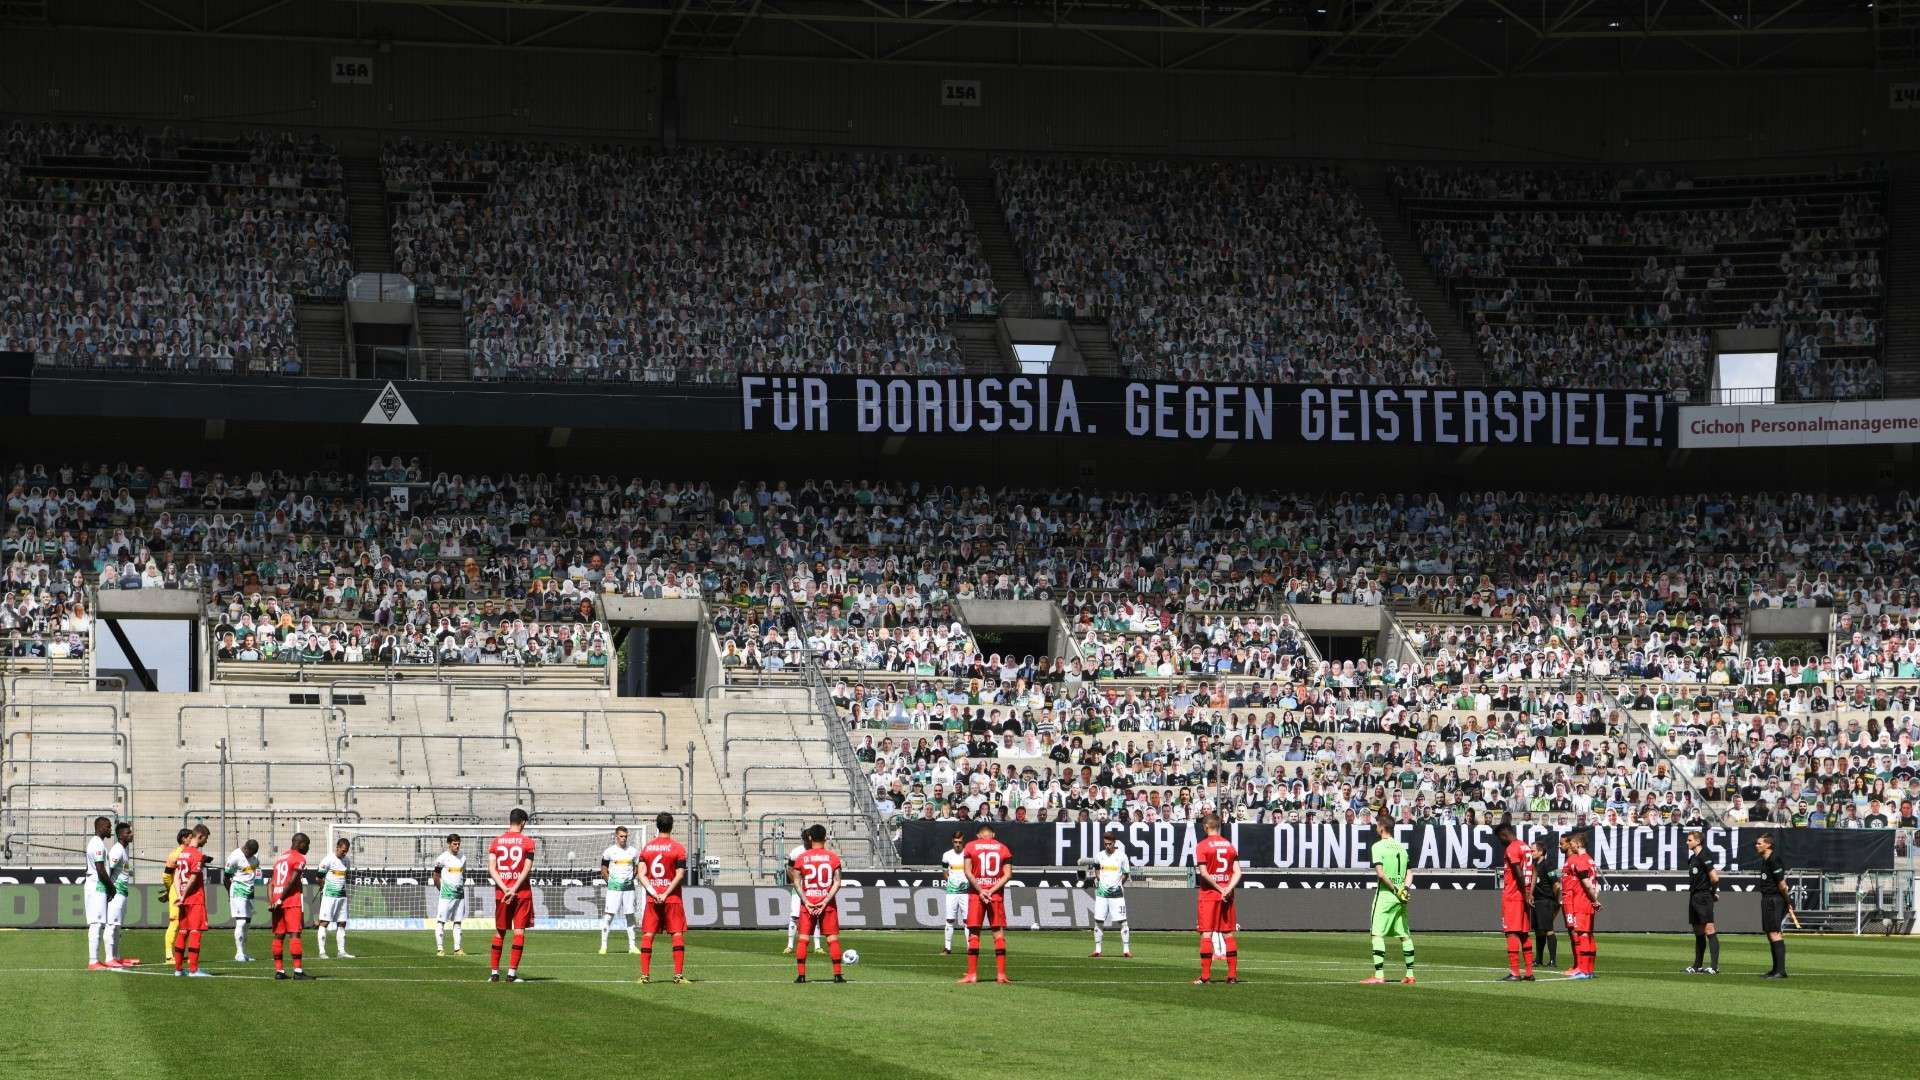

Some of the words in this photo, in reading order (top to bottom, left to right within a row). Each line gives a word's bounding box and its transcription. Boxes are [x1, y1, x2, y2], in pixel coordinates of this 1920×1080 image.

[336, 63, 369, 77] 16A
[946, 86, 977, 99] 15A
[742, 376, 829, 432] FÜR
[856, 377, 1097, 434] BORUSSIA.
[1125, 382, 1273, 439] GEGEN
[1300, 387, 1664, 447] GEISTERSPIELE!
[1690, 418, 1745, 434] Cichon
[1055, 821, 1251, 867] FUSSBAL
[1273, 822, 1371, 869] OHNE
[496, 845, 523, 871] 29
[651, 853, 665, 878] 6
[978, 851, 1000, 876] 10
[1216, 848, 1228, 872] 5
[1396, 852, 1401, 875] 1
[275, 860, 289, 886] 19
[529, 878, 554, 886] RAX
[803, 863, 832, 888] 20
[1329, 881, 1361, 889] BRAX
[755, 887, 867, 926] DE
[880, 887, 1113, 927] FOLEN
